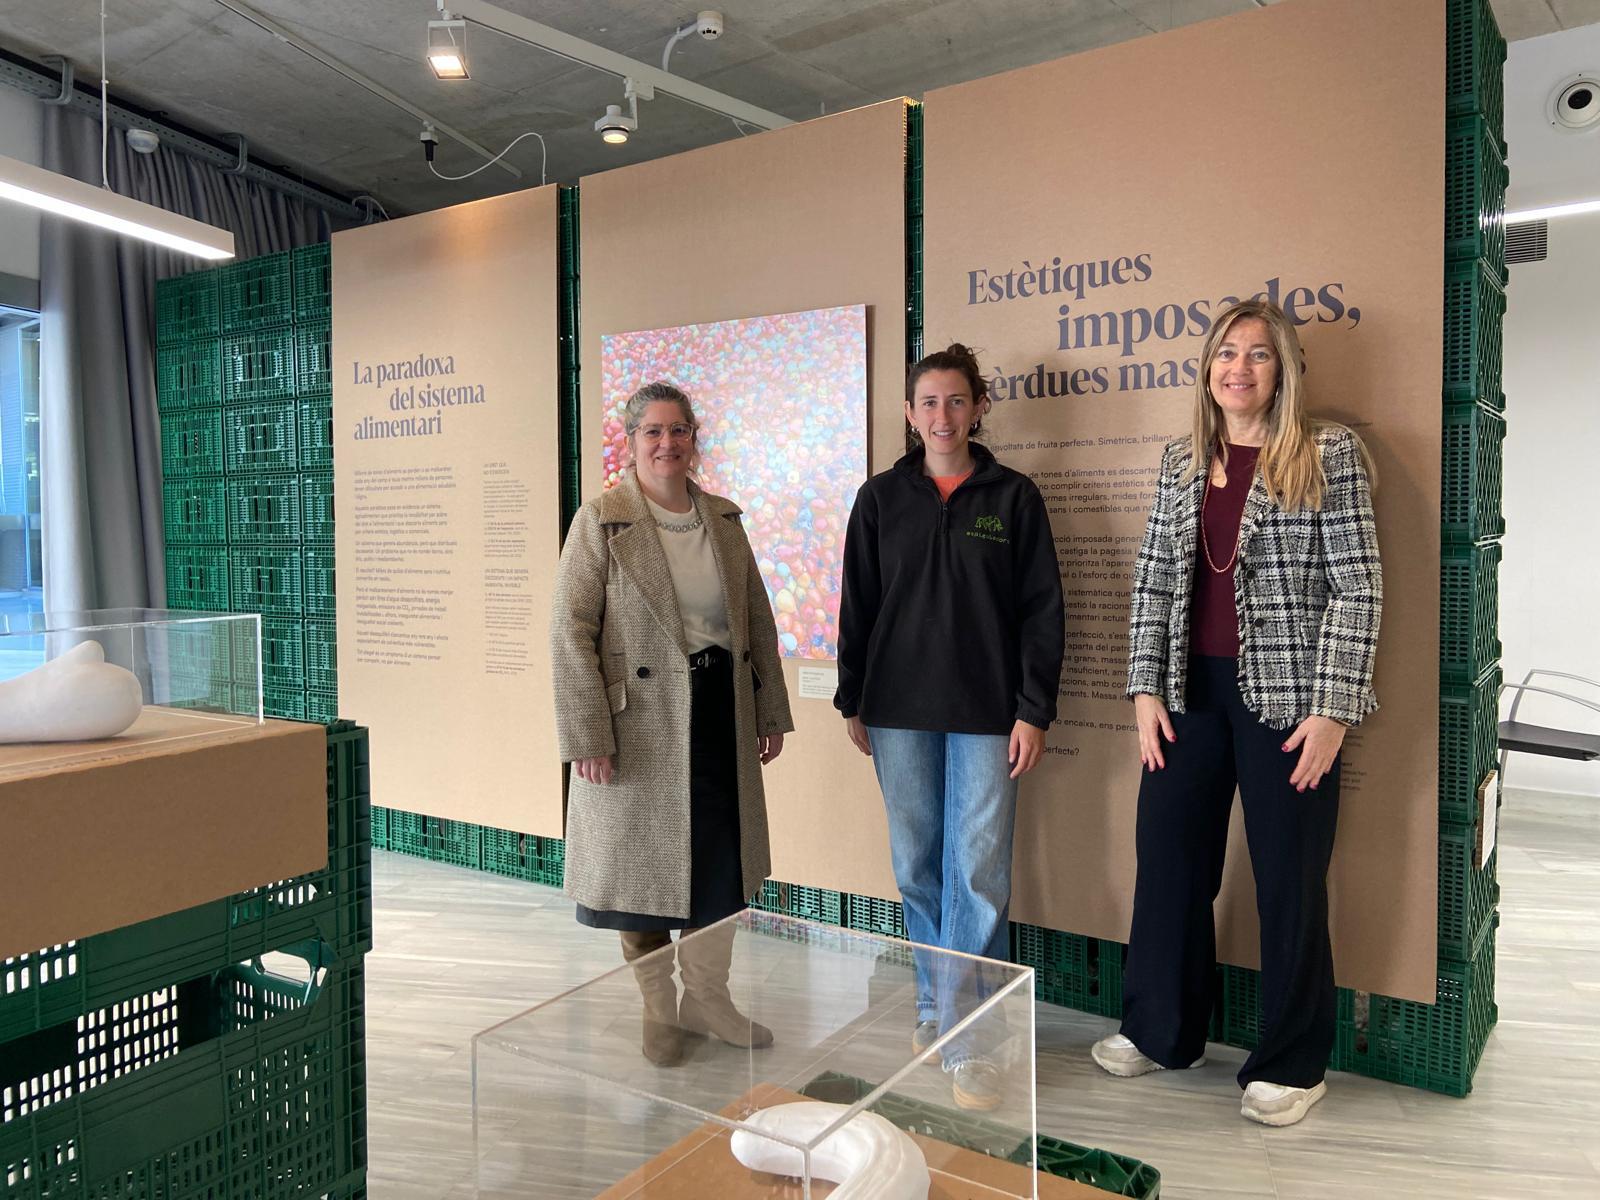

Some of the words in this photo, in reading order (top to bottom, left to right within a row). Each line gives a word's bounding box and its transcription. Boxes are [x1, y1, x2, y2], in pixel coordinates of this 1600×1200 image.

[967, 253, 1153, 305] Estètiques
[353, 361, 373, 385] La
[376, 353, 456, 389] paradoxa
[988, 363, 1109, 402] èrdues
[389, 385, 415, 411] del
[418, 383, 486, 410] sistema
[354, 409, 443, 440] alimentari
[1026, 441, 1036, 450] de
[1038, 440, 1058, 449] fruita
[1041, 471, 1062, 479] tones
[1050, 481, 1081, 490] complir
[1083, 481, 1111, 489] criteris
[1112, 492, 1138, 500] mides
[1073, 504, 1122, 514] comestibles
[1124, 506, 1141, 514] que
[1054, 534, 1071, 543] cció
[1073, 535, 1113, 544] imposada
[1060, 547, 1089, 557] castiga
[1090, 547, 1098, 555] la
[1066, 559, 1100, 568] prioritza
[1101, 559, 1136, 568] l'aparen
[1089, 601, 1097, 609] la
[1065, 612, 1100, 621] limentari
[1095, 643, 1109, 651] del
[1091, 680, 1110, 688] amb
[1091, 690, 1118, 700] Massa
[1099, 722, 1114, 730] ens
